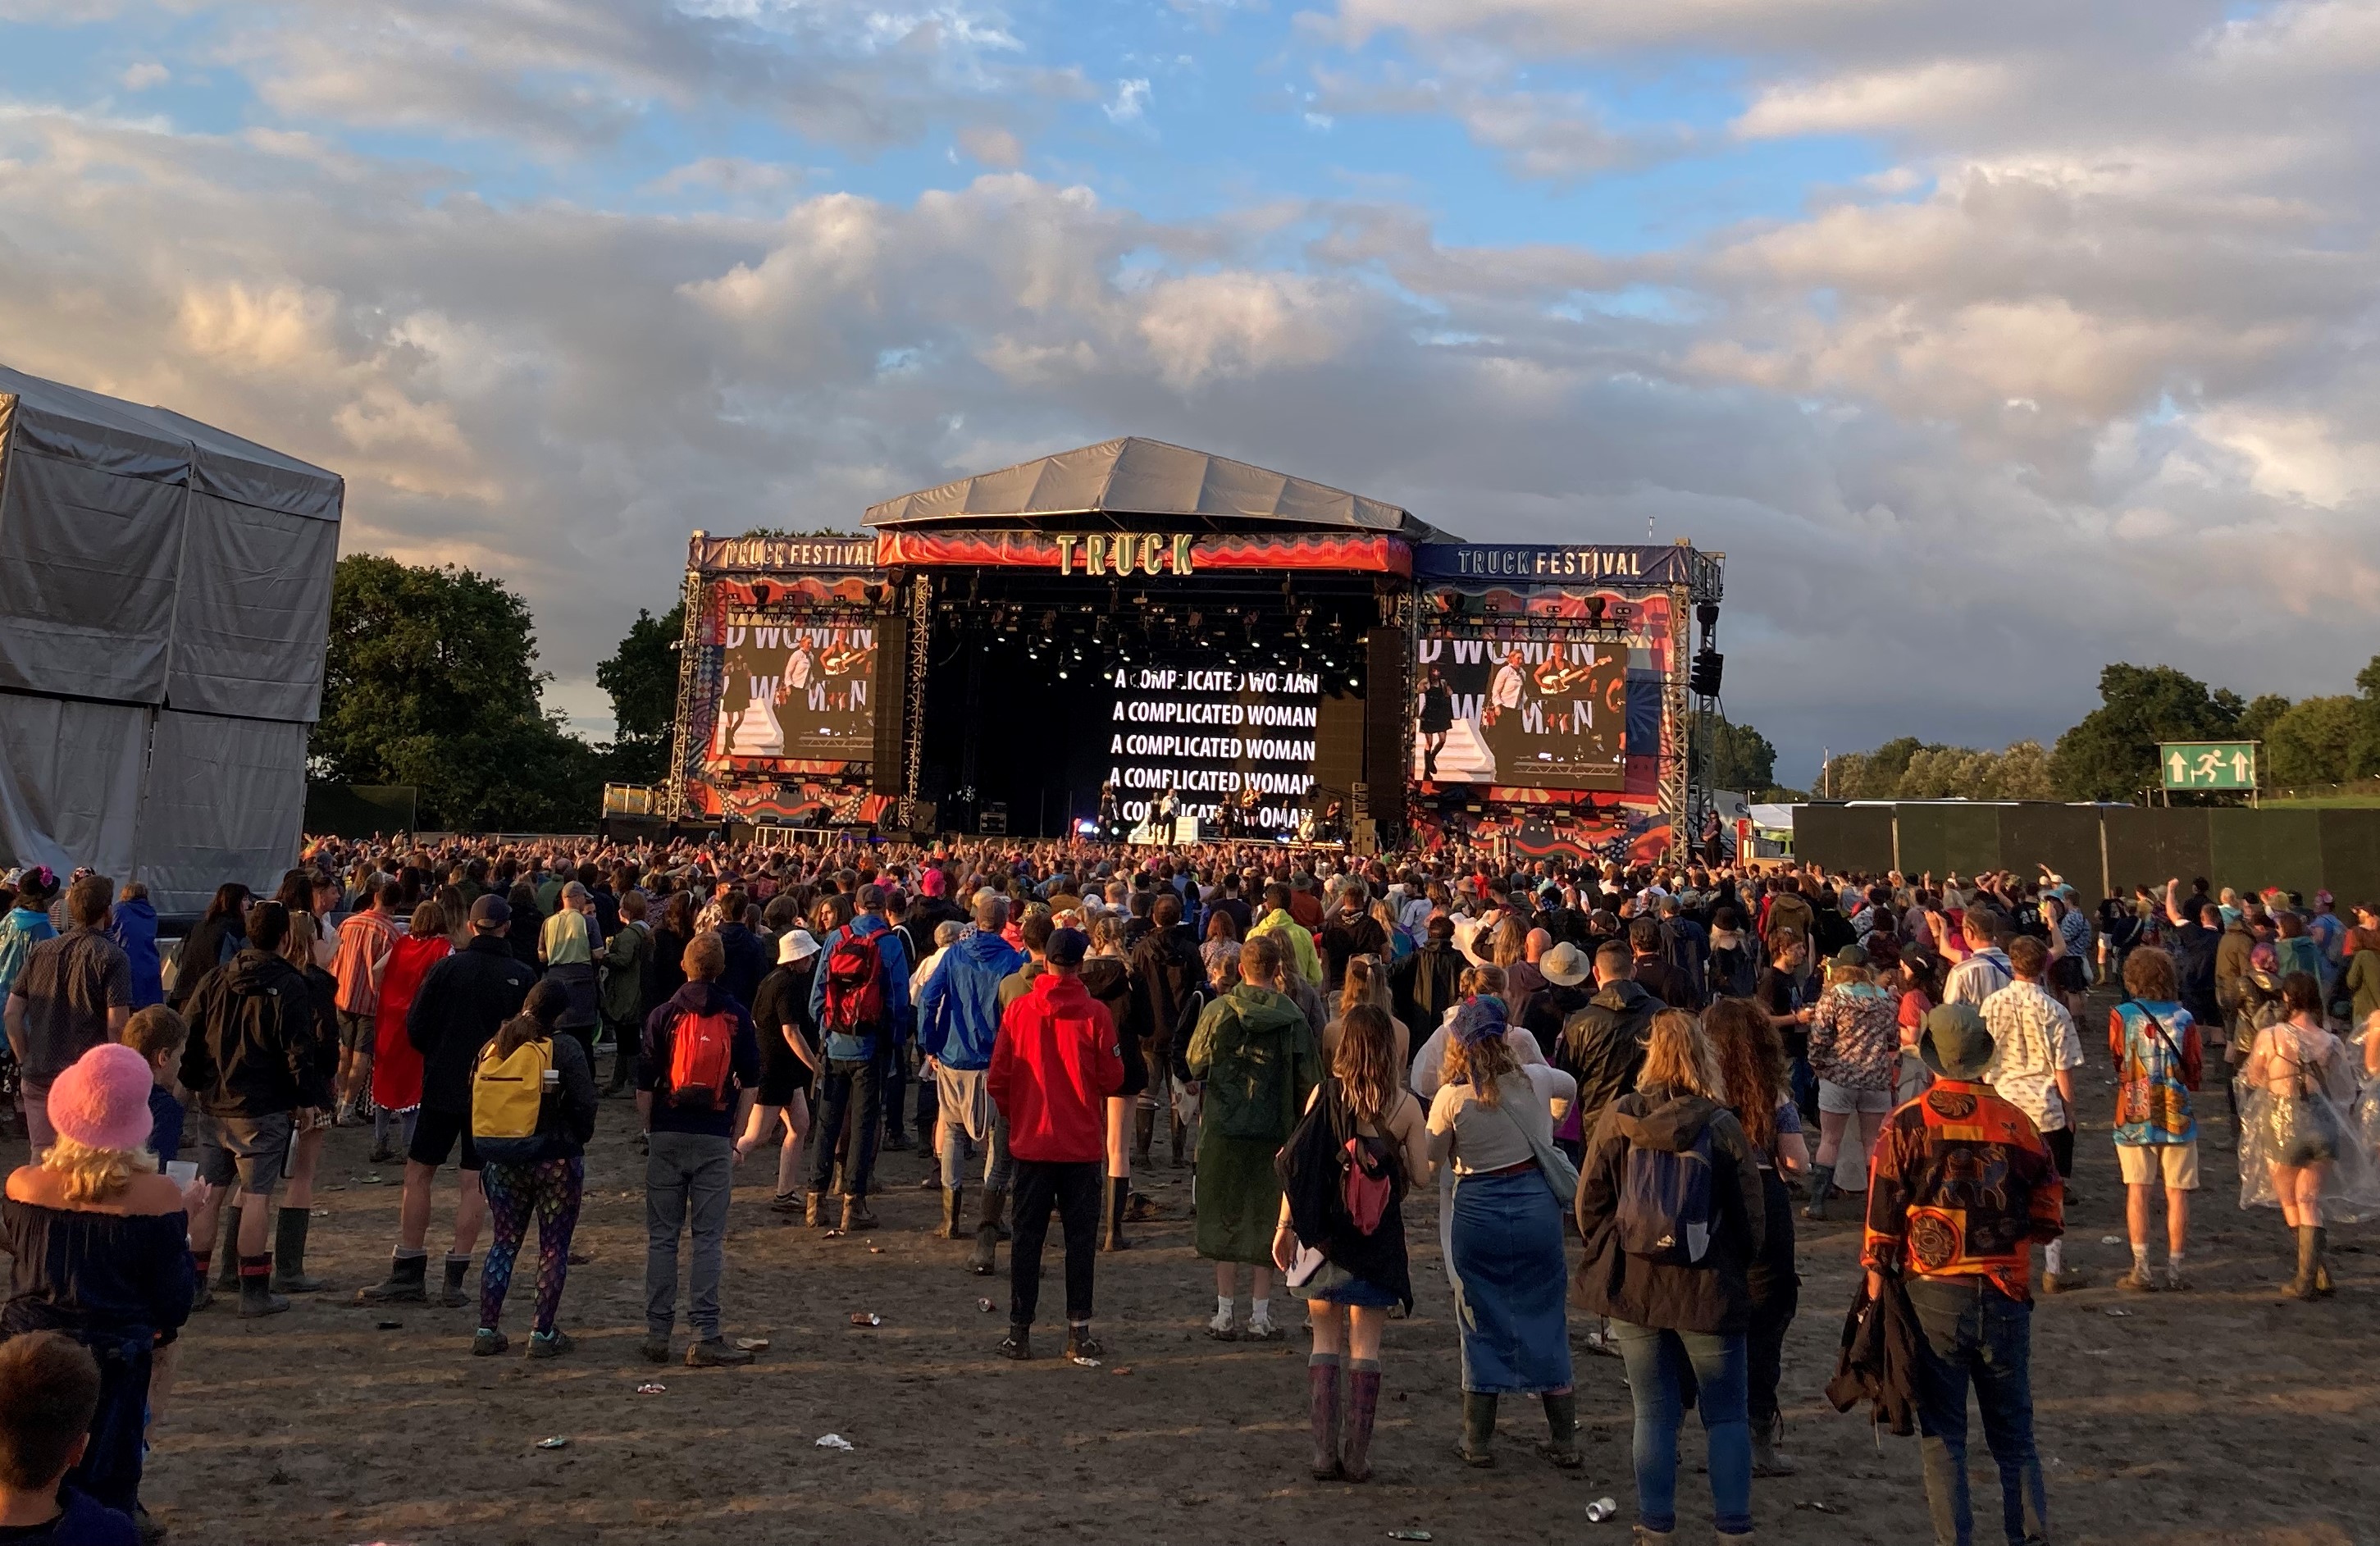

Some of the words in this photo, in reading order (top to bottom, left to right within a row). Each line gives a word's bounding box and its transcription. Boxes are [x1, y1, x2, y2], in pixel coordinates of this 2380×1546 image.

[727, 539, 785, 567] TRUCK
[790, 544, 874, 565] FESTIVAL
[1055, 532, 1193, 577] TRUCK
[1457, 550, 1530, 574] TRUCK
[1536, 552, 1641, 577] FESTIVAL
[1115, 668, 1126, 688] A
[1113, 701, 1124, 721] A
[1128, 701, 1244, 724] COMPLICATED
[1247, 705, 1317, 727] WOMAN
[1110, 734, 1123, 754] A
[1126, 735, 1242, 758] COMPLICATED
[1246, 739, 1315, 760] WOMAN
[1110, 767, 1120, 787] A
[1124, 768, 1241, 791] COMPLICATED
[1244, 772, 1314, 795] WOMAN
